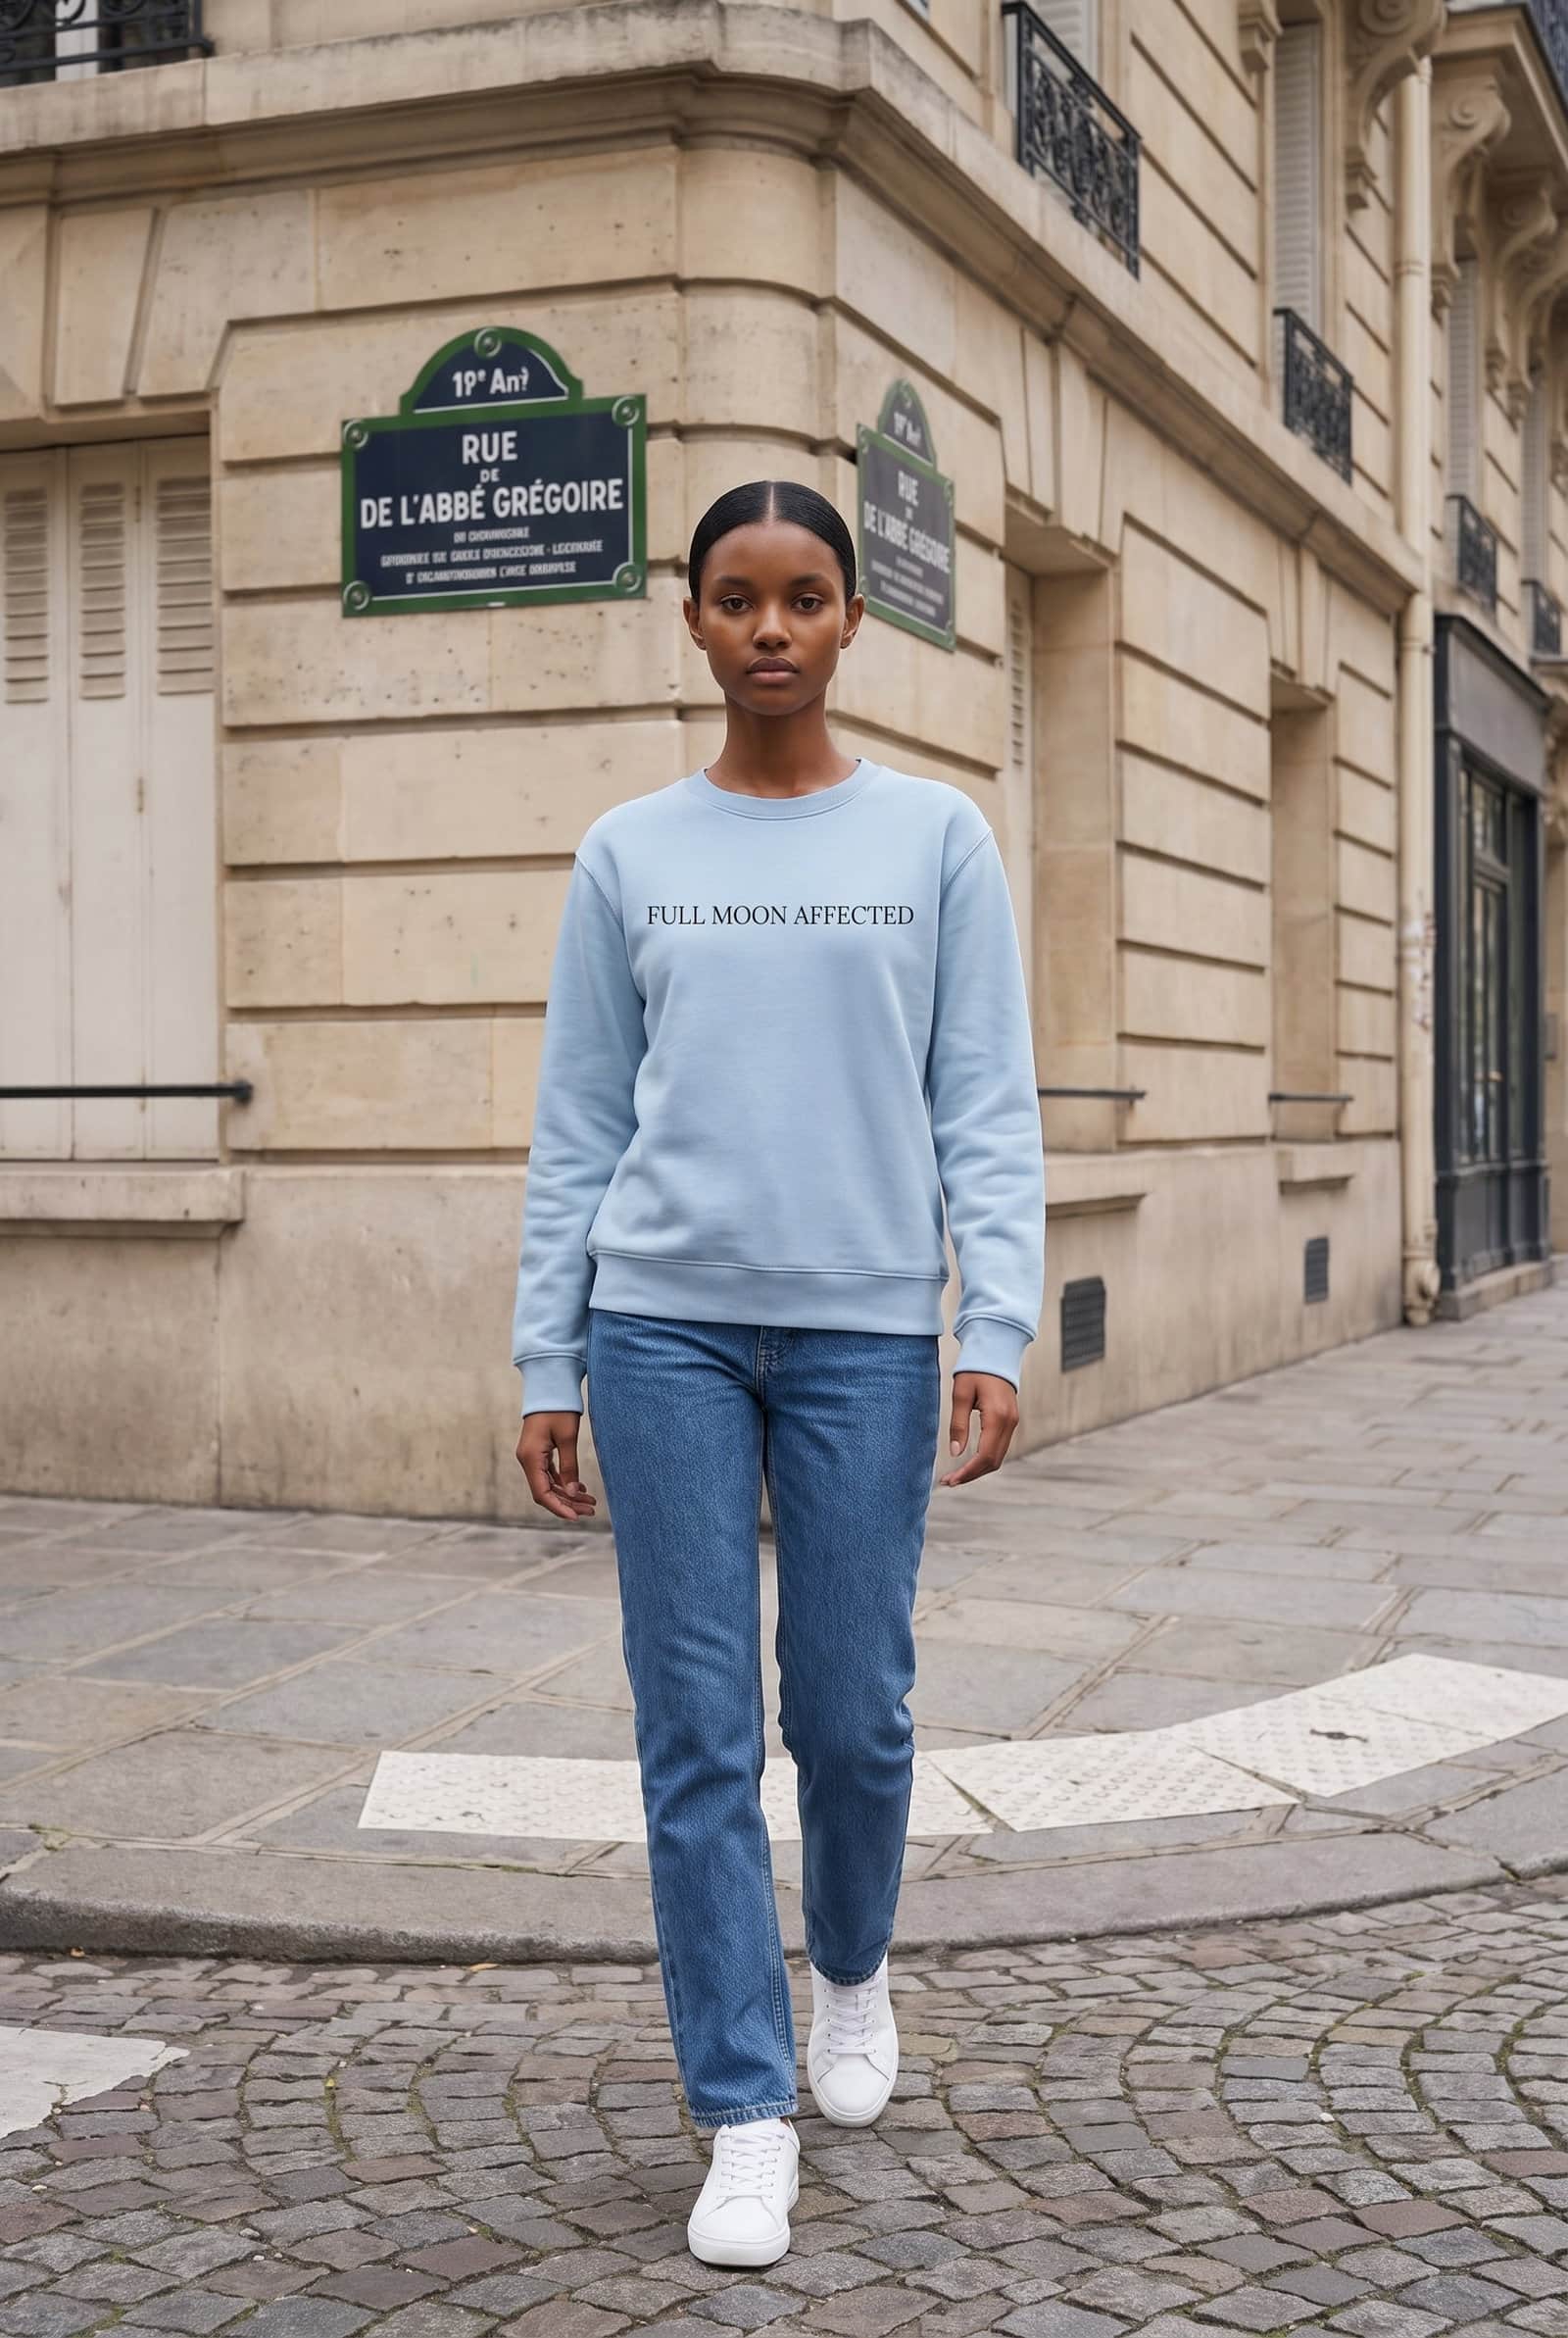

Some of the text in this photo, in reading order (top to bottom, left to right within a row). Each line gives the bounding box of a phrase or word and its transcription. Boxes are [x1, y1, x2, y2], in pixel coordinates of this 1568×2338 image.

[462, 430, 518, 465] RUE
[480, 469, 500, 483] DE
[361, 478, 623, 529] DE L'ABBÉ GRÉGOIRE
[647, 905, 914, 925] FULL MOON AFFECTED
